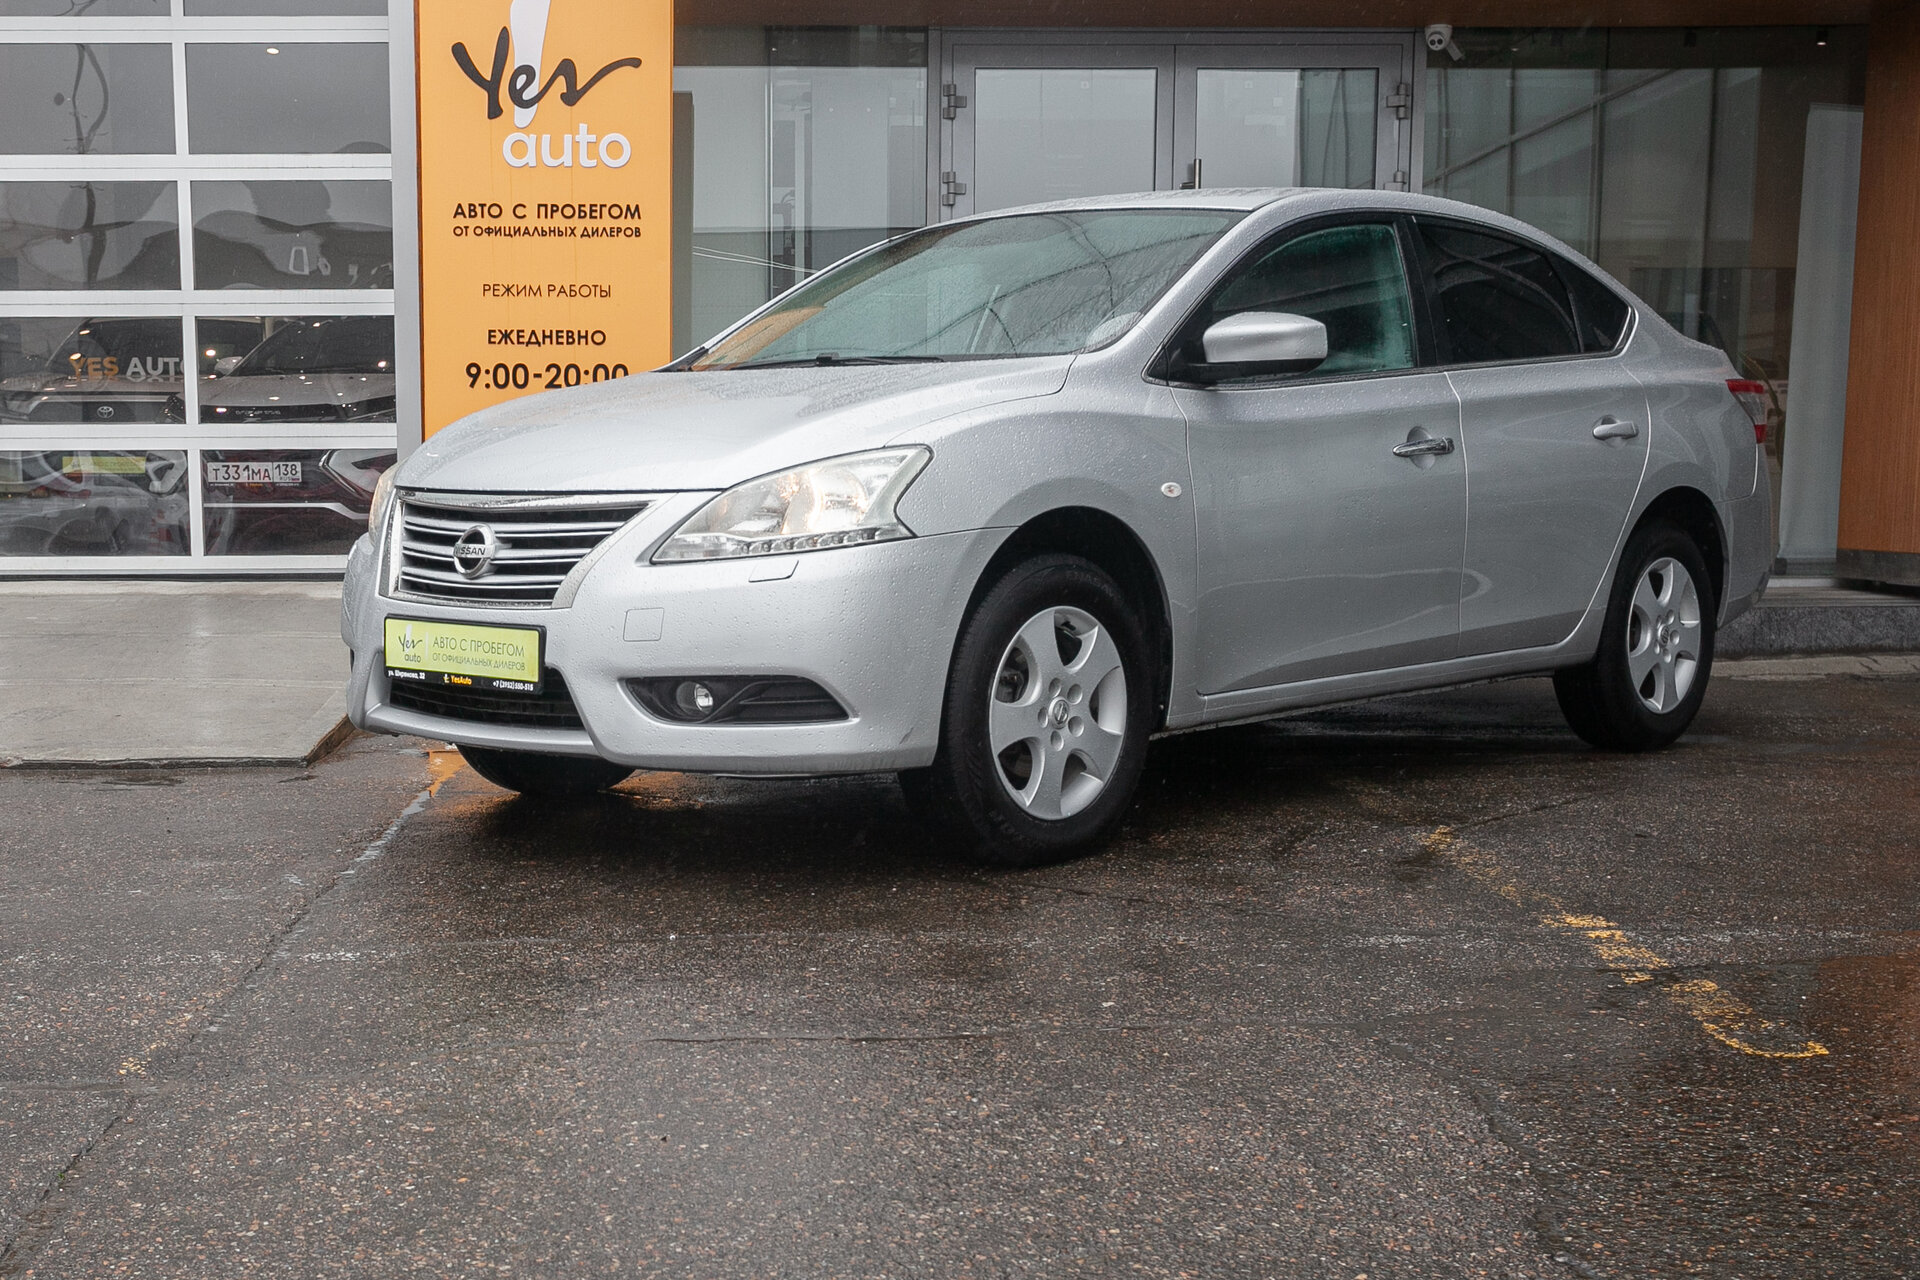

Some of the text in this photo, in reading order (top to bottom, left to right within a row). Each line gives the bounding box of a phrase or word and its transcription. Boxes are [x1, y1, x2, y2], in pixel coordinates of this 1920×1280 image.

[451, 26, 642, 119] Yes
[503, 123, 631, 168] auto
[453, 203, 641, 220] АВТО С ПРОБЕГОМ
[453, 226, 641, 238] ОТ ОФИЦИАЛЬНЫХ ДИЛЕРОВ
[482, 284, 611, 298] РЕЖИМ РАБОТЫ
[487, 329, 606, 347] ЕЖЕДНЕВНО
[69, 357, 185, 377] YES AUT
[275, 463, 298, 476] 138
[432, 636, 525, 657] АВТО С ПРОБЕГОМ
[404, 653, 422, 663] auto
[432, 652, 526, 671] ОТ ОФИЦИАЛЬНЫХ ДИЛЕРОВ
[450, 675, 473, 685] YesAuto
